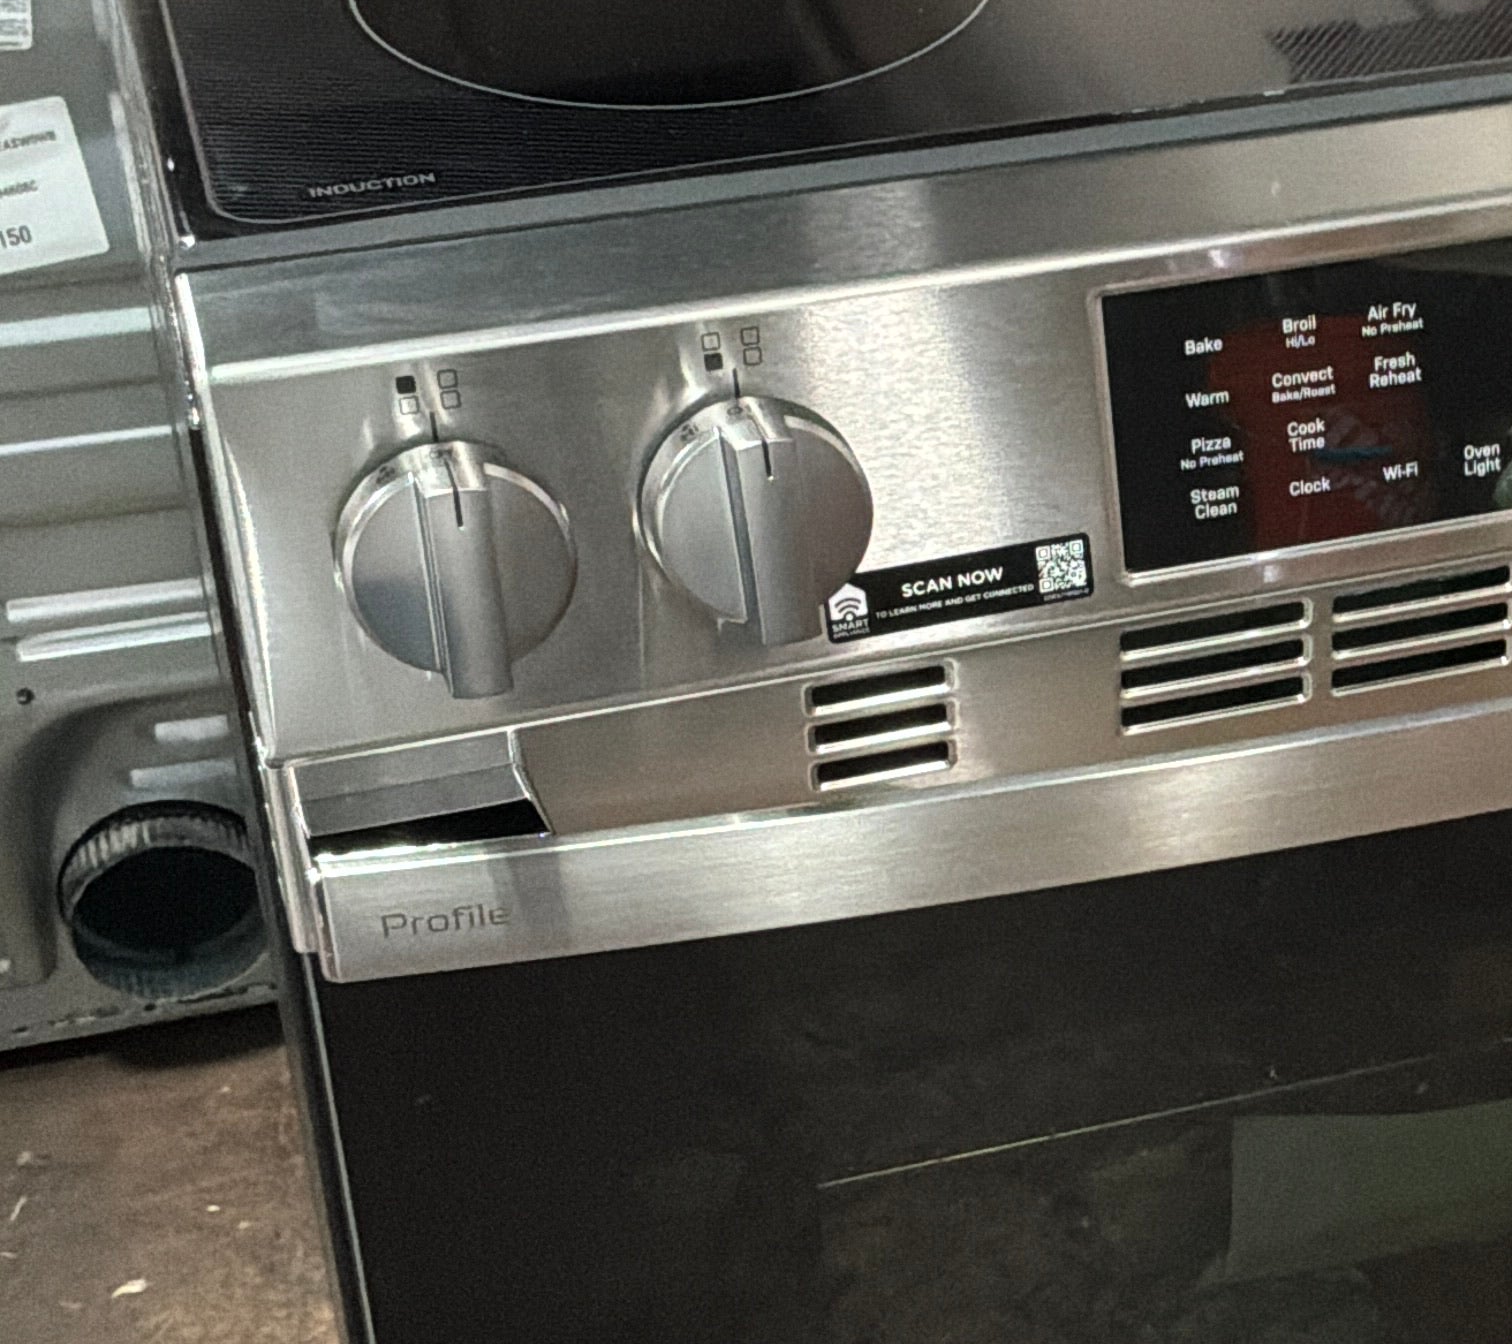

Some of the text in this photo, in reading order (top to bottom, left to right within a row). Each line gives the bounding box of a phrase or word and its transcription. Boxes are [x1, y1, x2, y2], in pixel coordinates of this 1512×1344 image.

[307, 172, 436, 199] INDUCTION
[1368, 301, 1417, 322] Air Fry
[1282, 314, 1317, 334] Broil
[1362, 317, 1425, 338] No Preheat
[1184, 336, 1223, 355] Bake
[1374, 351, 1415, 371] Fresh
[1272, 365, 1334, 388] Convect
[1369, 367, 1422, 389] Reheat
[1185, 390, 1230, 408] Warm
[1287, 417, 1325, 437] Cook
[1191, 436, 1232, 454] Pizza
[1288, 436, 1325, 453] Time
[1464, 443, 1500, 460] Oven
[1180, 450, 1244, 471] No Preheat
[1464, 457, 1501, 477] Light
[1382, 461, 1419, 482] Wi-Fi
[1190, 485, 1240, 504] Steam
[1289, 476, 1331, 497] Clock
[1195, 502, 1238, 519] Clean
[901, 566, 1004, 598] SCAN NOW
[945, 596, 964, 606] AND
[965, 593, 981, 603] GET
[831, 618, 869, 633] SMART
[381, 903, 511, 939] Profile
